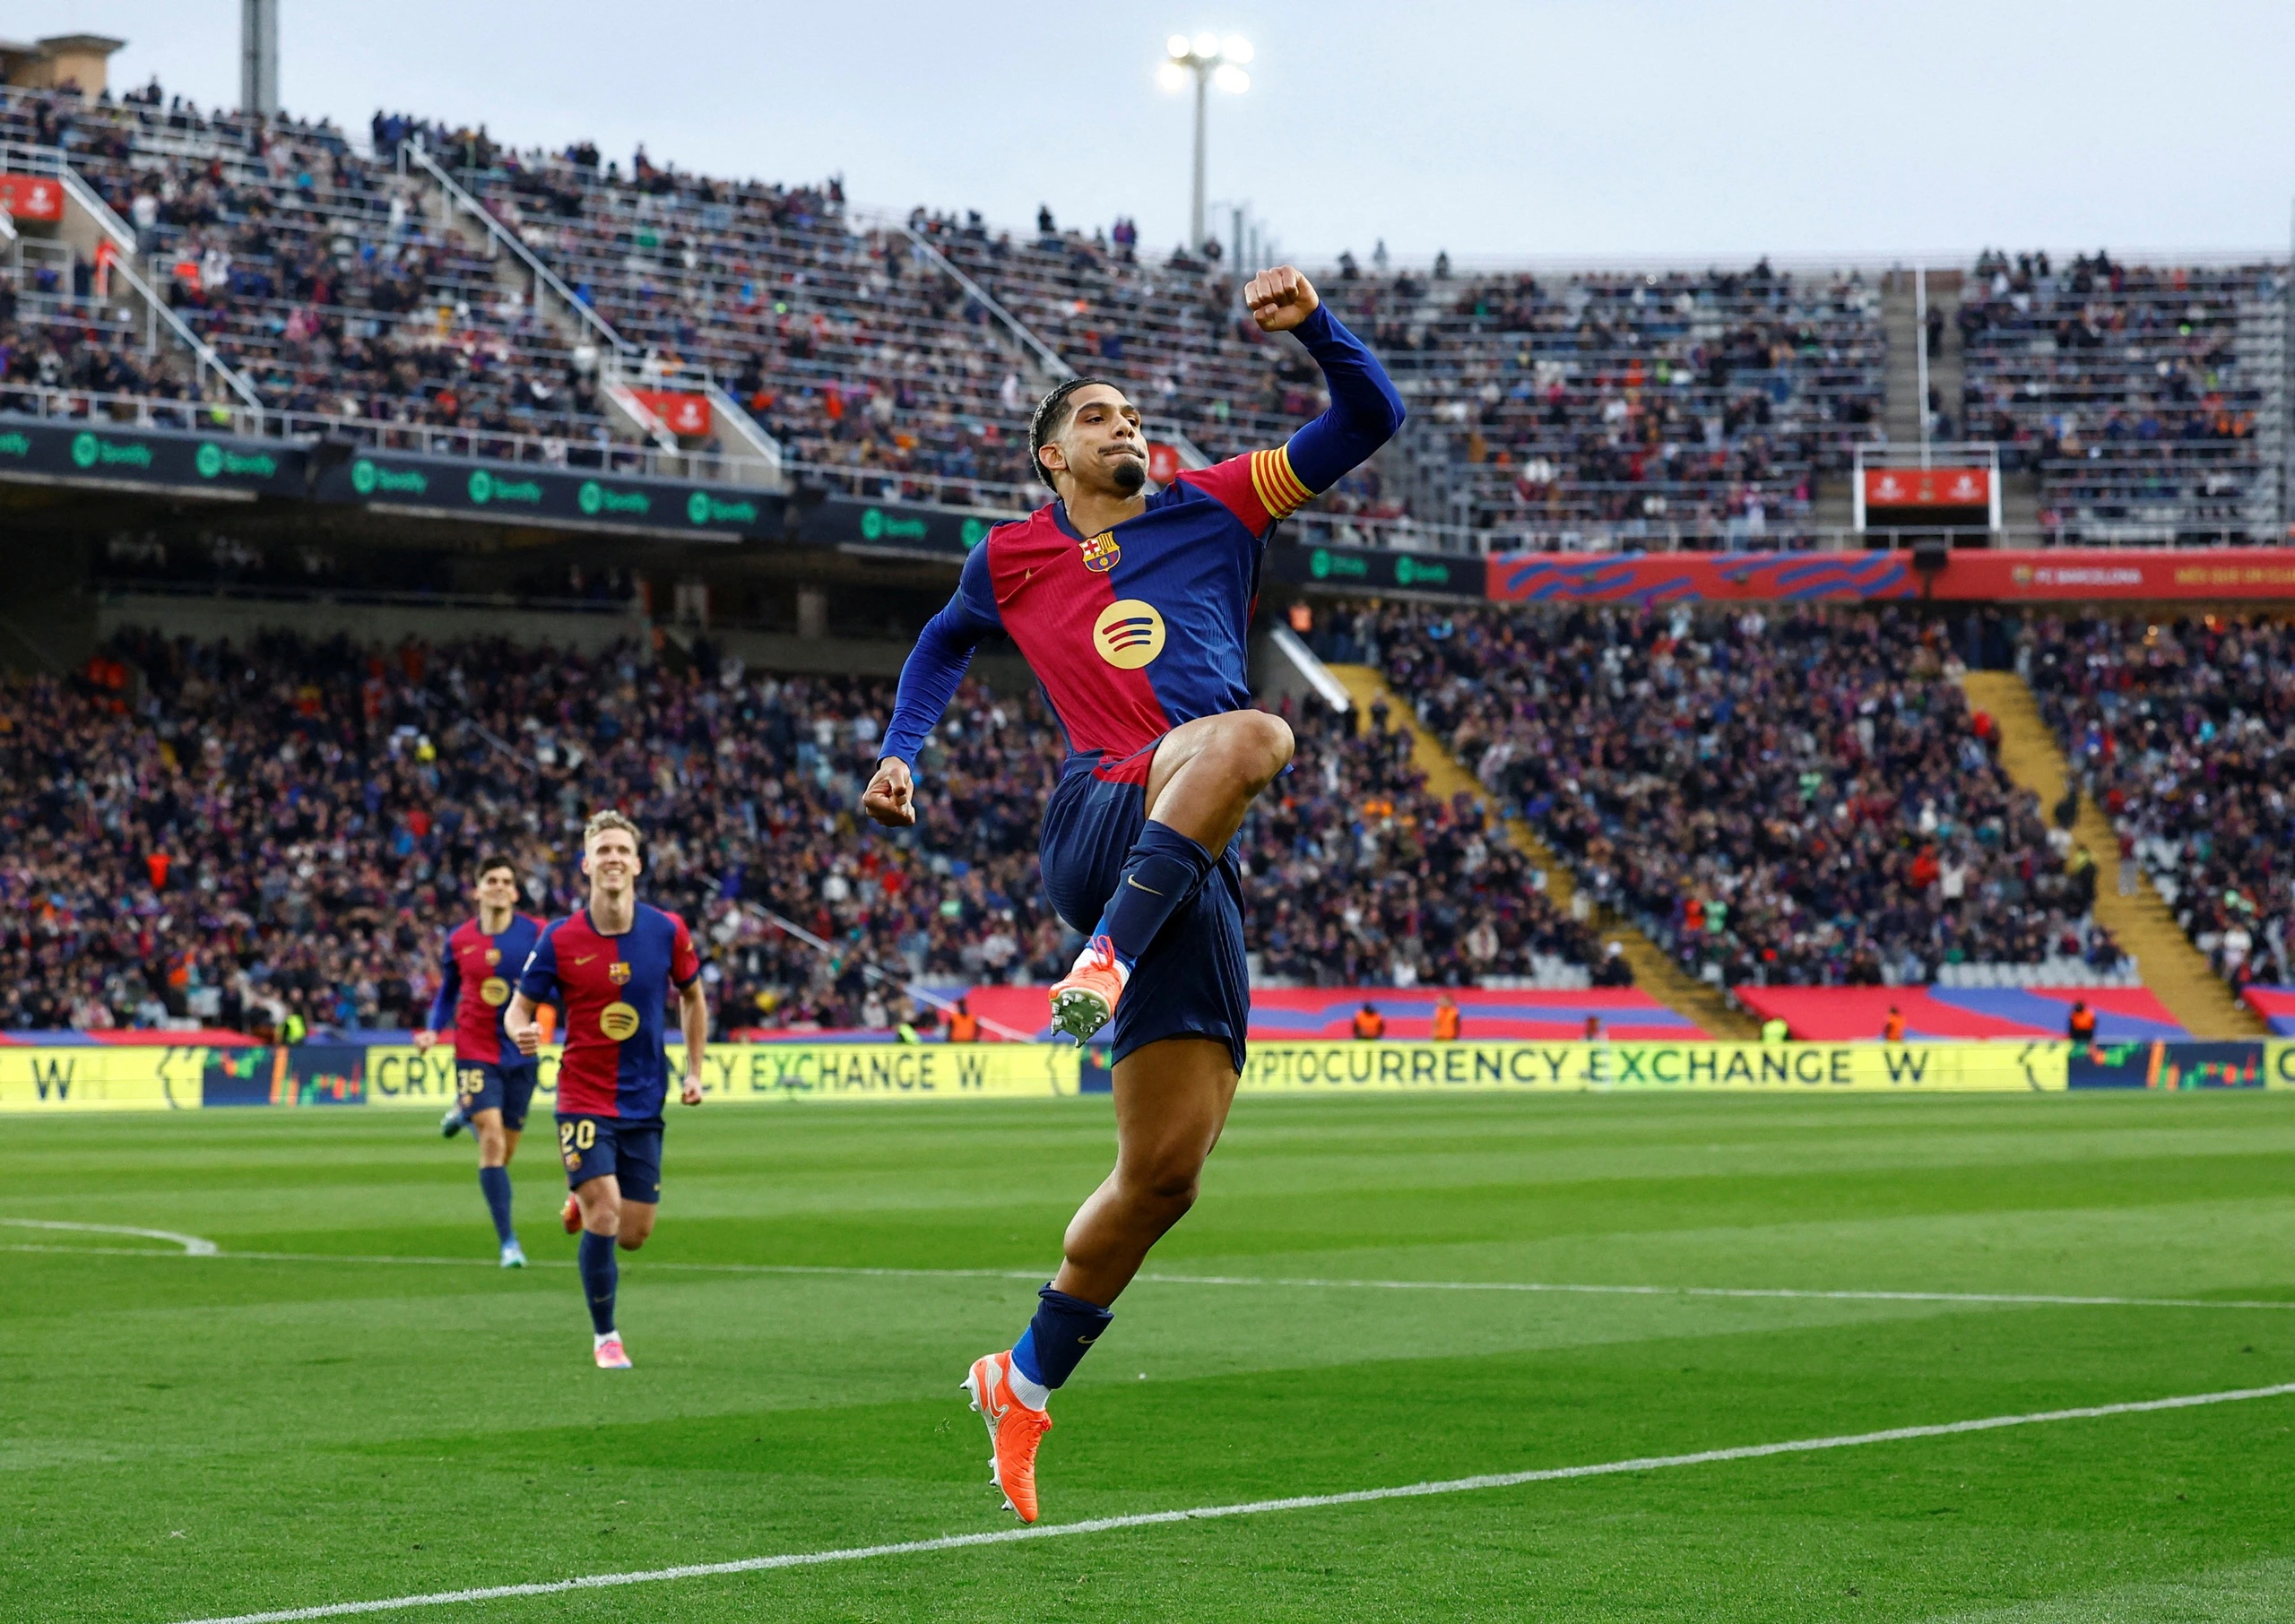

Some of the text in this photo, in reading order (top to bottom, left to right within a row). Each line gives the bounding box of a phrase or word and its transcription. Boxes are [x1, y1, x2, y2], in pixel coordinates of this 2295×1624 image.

[751, 1052, 936, 1091] EXCHANGE
[1245, 1049, 1569, 1083] YPTOCURRENCY
[1589, 1049, 1850, 1084] EXCHANGE
[560, 1119, 596, 1154] 20
